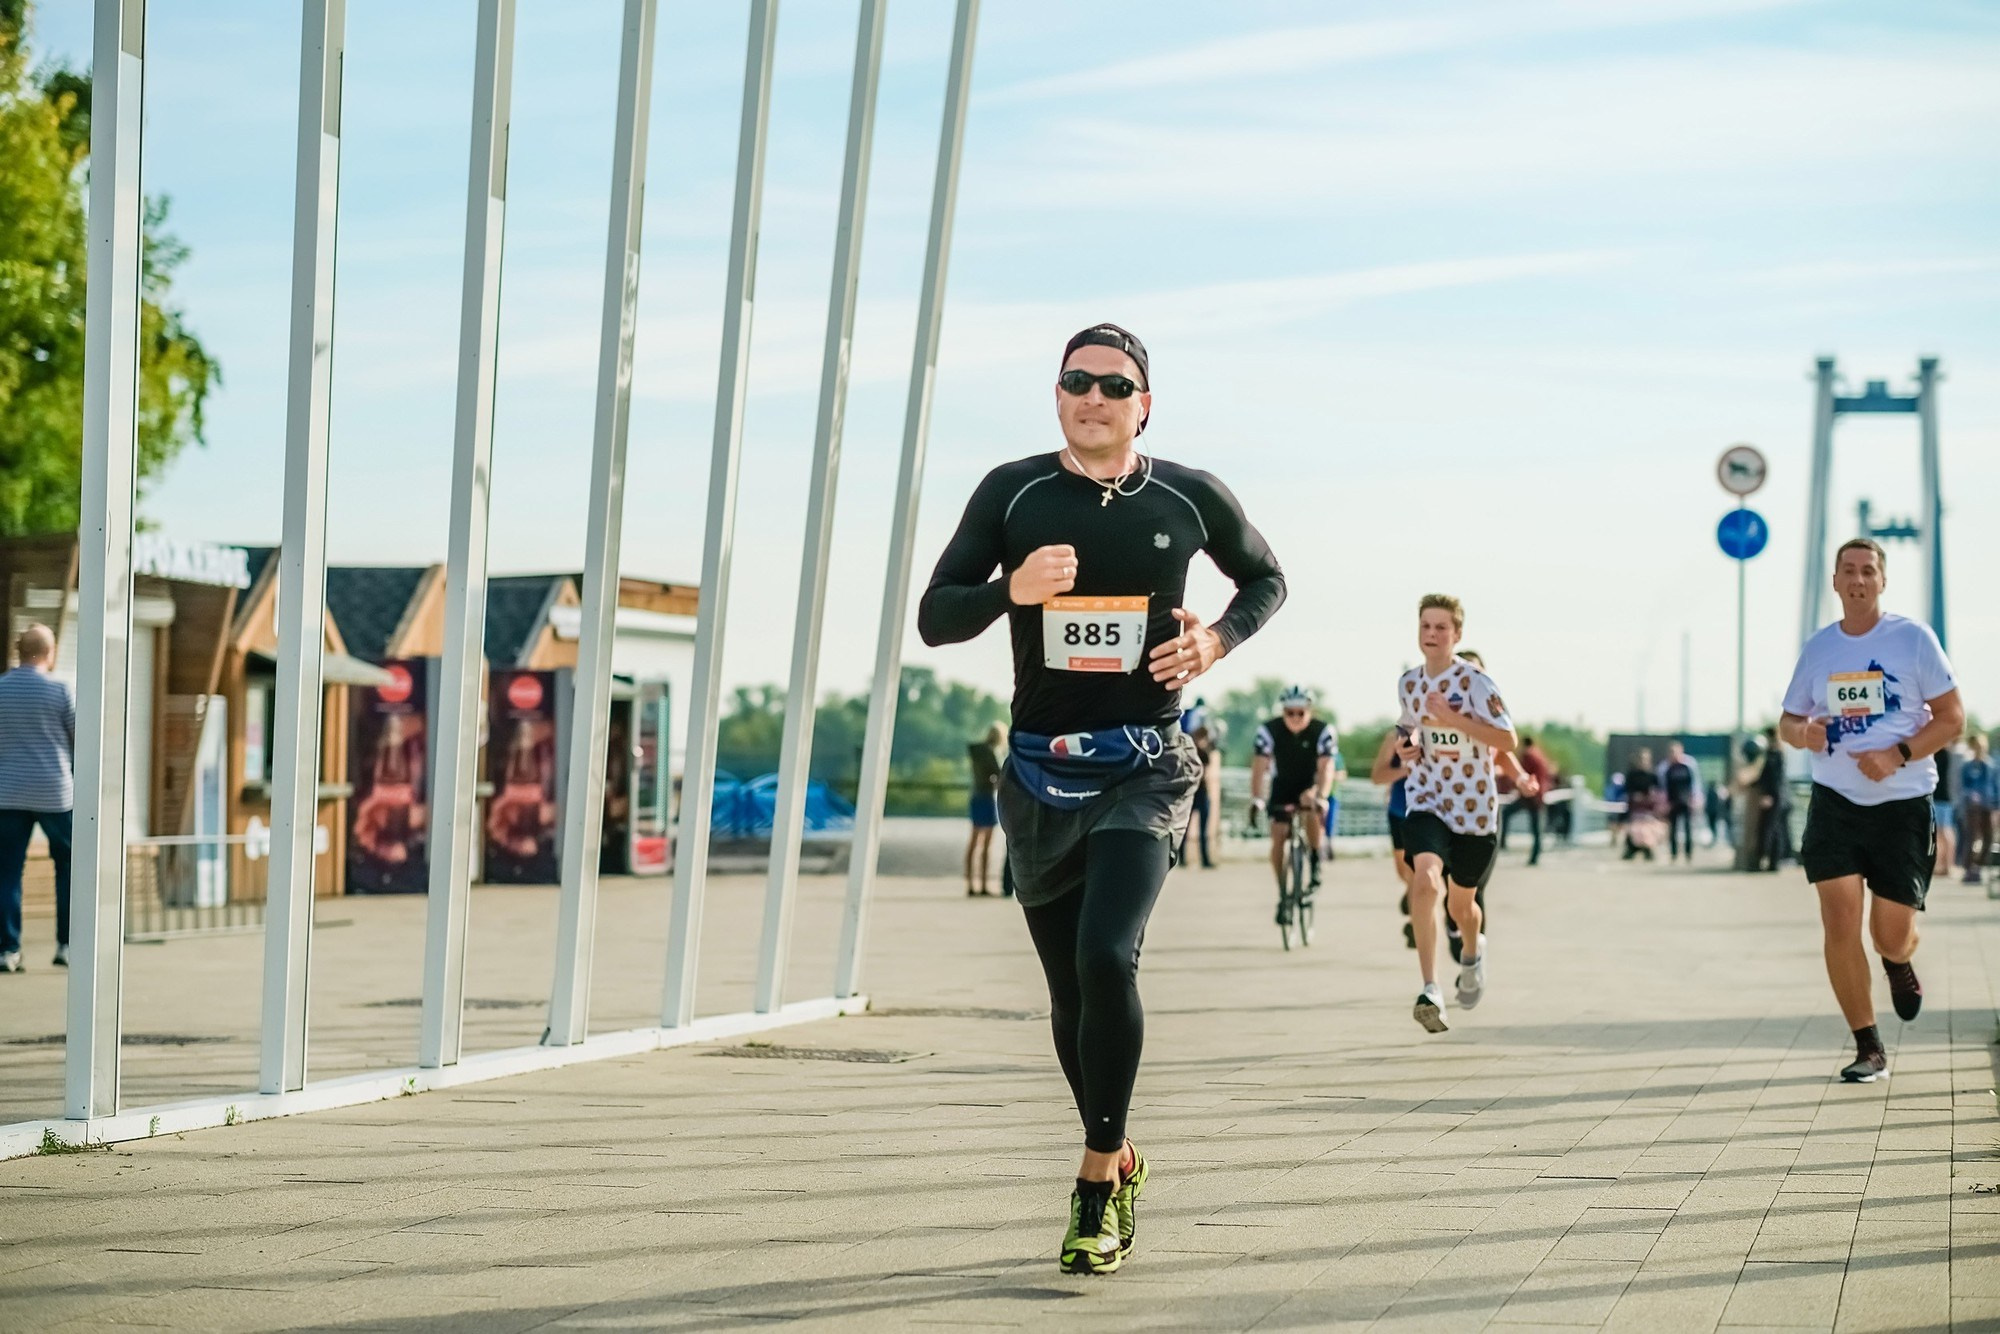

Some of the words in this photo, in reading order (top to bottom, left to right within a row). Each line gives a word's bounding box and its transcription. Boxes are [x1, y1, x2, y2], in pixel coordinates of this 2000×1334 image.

[1064, 623, 1120, 646] 885
[1838, 687, 1869, 702] 664
[1431, 732, 1459, 745] 910
